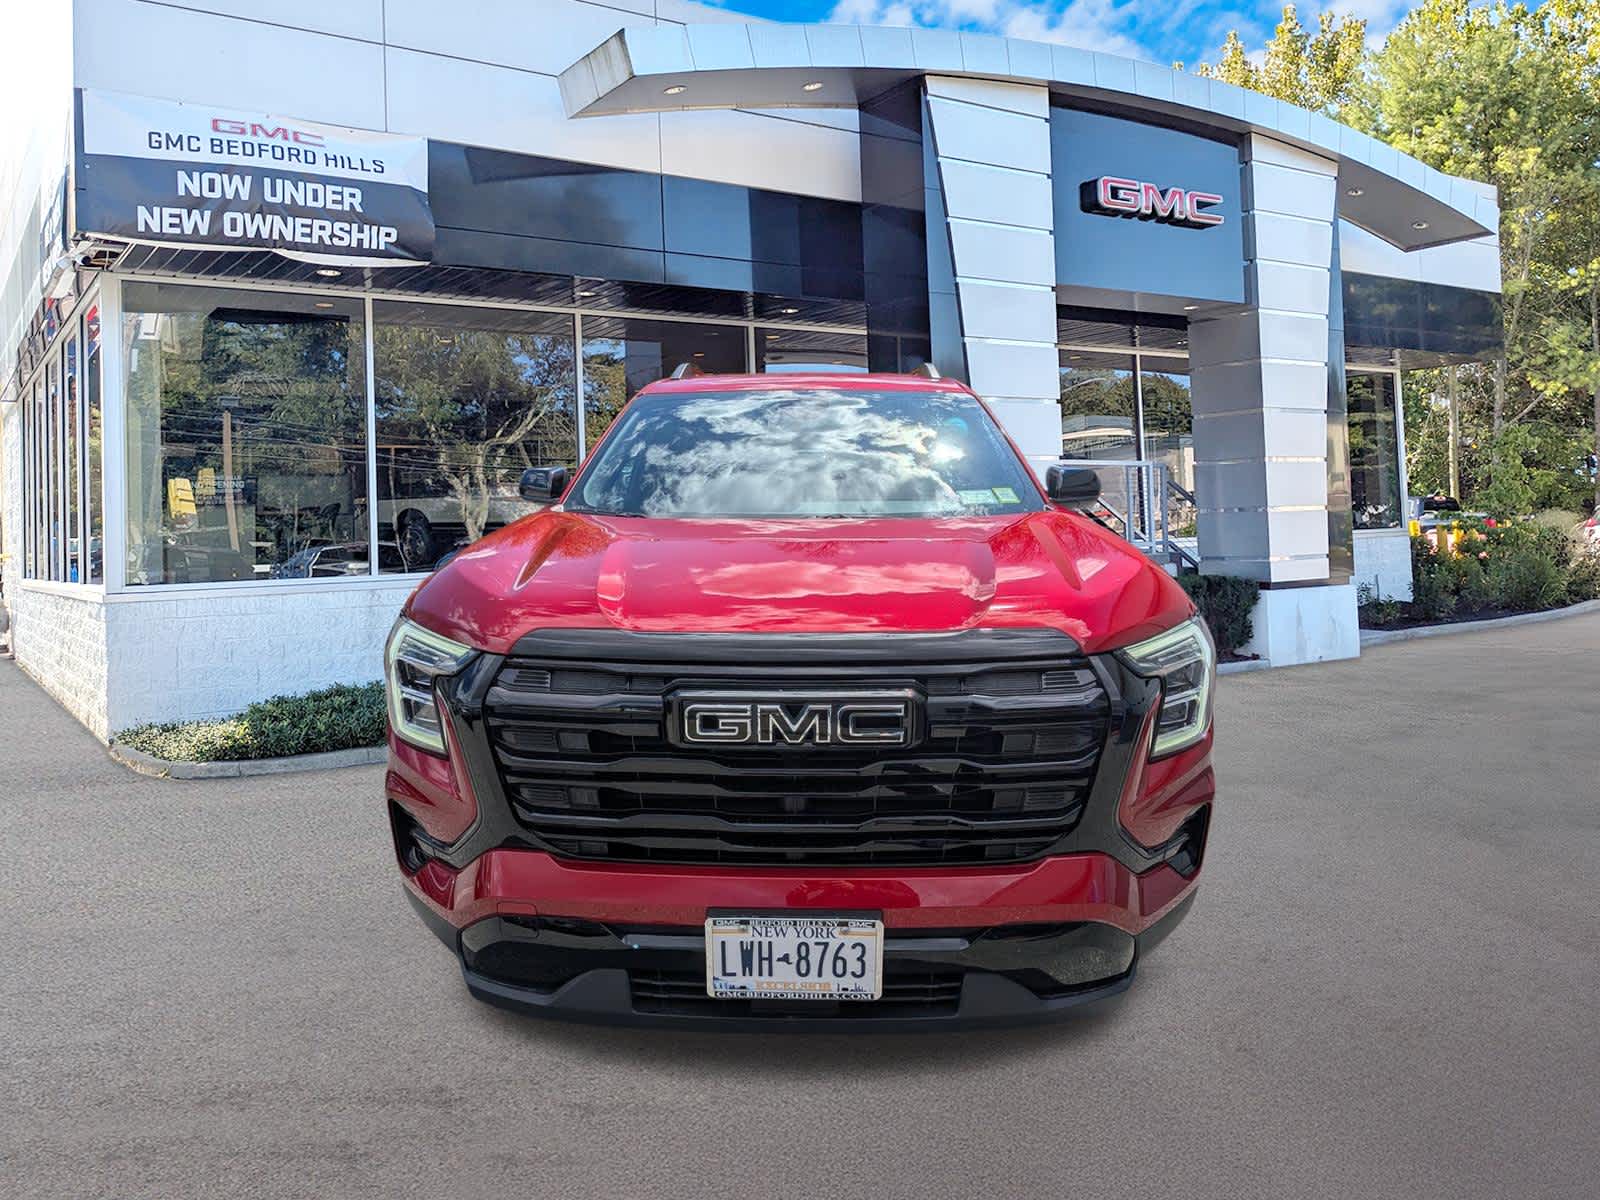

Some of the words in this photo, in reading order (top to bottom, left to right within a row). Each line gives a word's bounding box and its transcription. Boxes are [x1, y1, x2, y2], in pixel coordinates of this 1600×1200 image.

[148, 131, 201, 152] GMC
[209, 138, 316, 165] BEDFORD
[324, 152, 385, 174] HILLS
[210, 118, 325, 148] GMC
[176, 170, 252, 201] NOW
[263, 177, 364, 213] UNDER
[1097, 175, 1225, 225] GMC
[137, 205, 212, 236] NEW
[223, 211, 398, 250] OWNERSHIP
[684, 704, 905, 744] GMC
[751, 926, 789, 939] NEW
[793, 926, 838, 939] YORK
